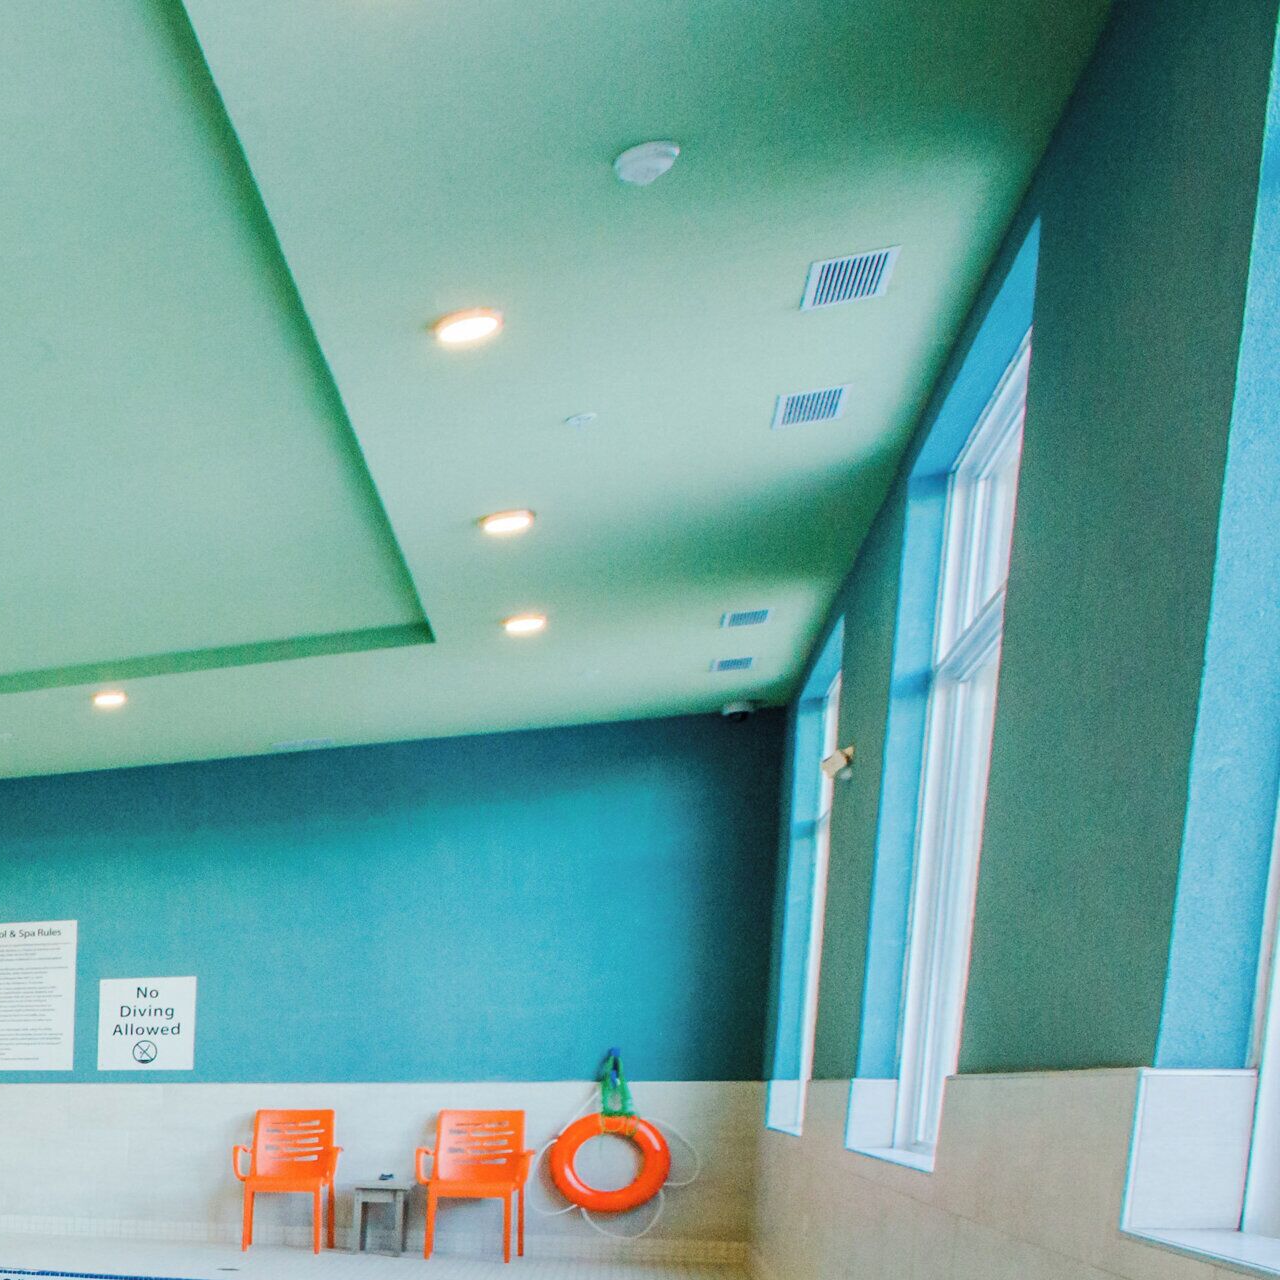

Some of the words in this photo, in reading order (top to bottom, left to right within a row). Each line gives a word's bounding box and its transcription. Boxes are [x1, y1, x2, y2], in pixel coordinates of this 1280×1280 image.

[9, 929, 16, 938] &
[19, 929, 36, 939] Spa
[37, 927, 62, 937] Rules
[136, 986, 159, 999] No
[120, 1004, 174, 1020] Diving
[112, 1022, 181, 1036] Allowed
